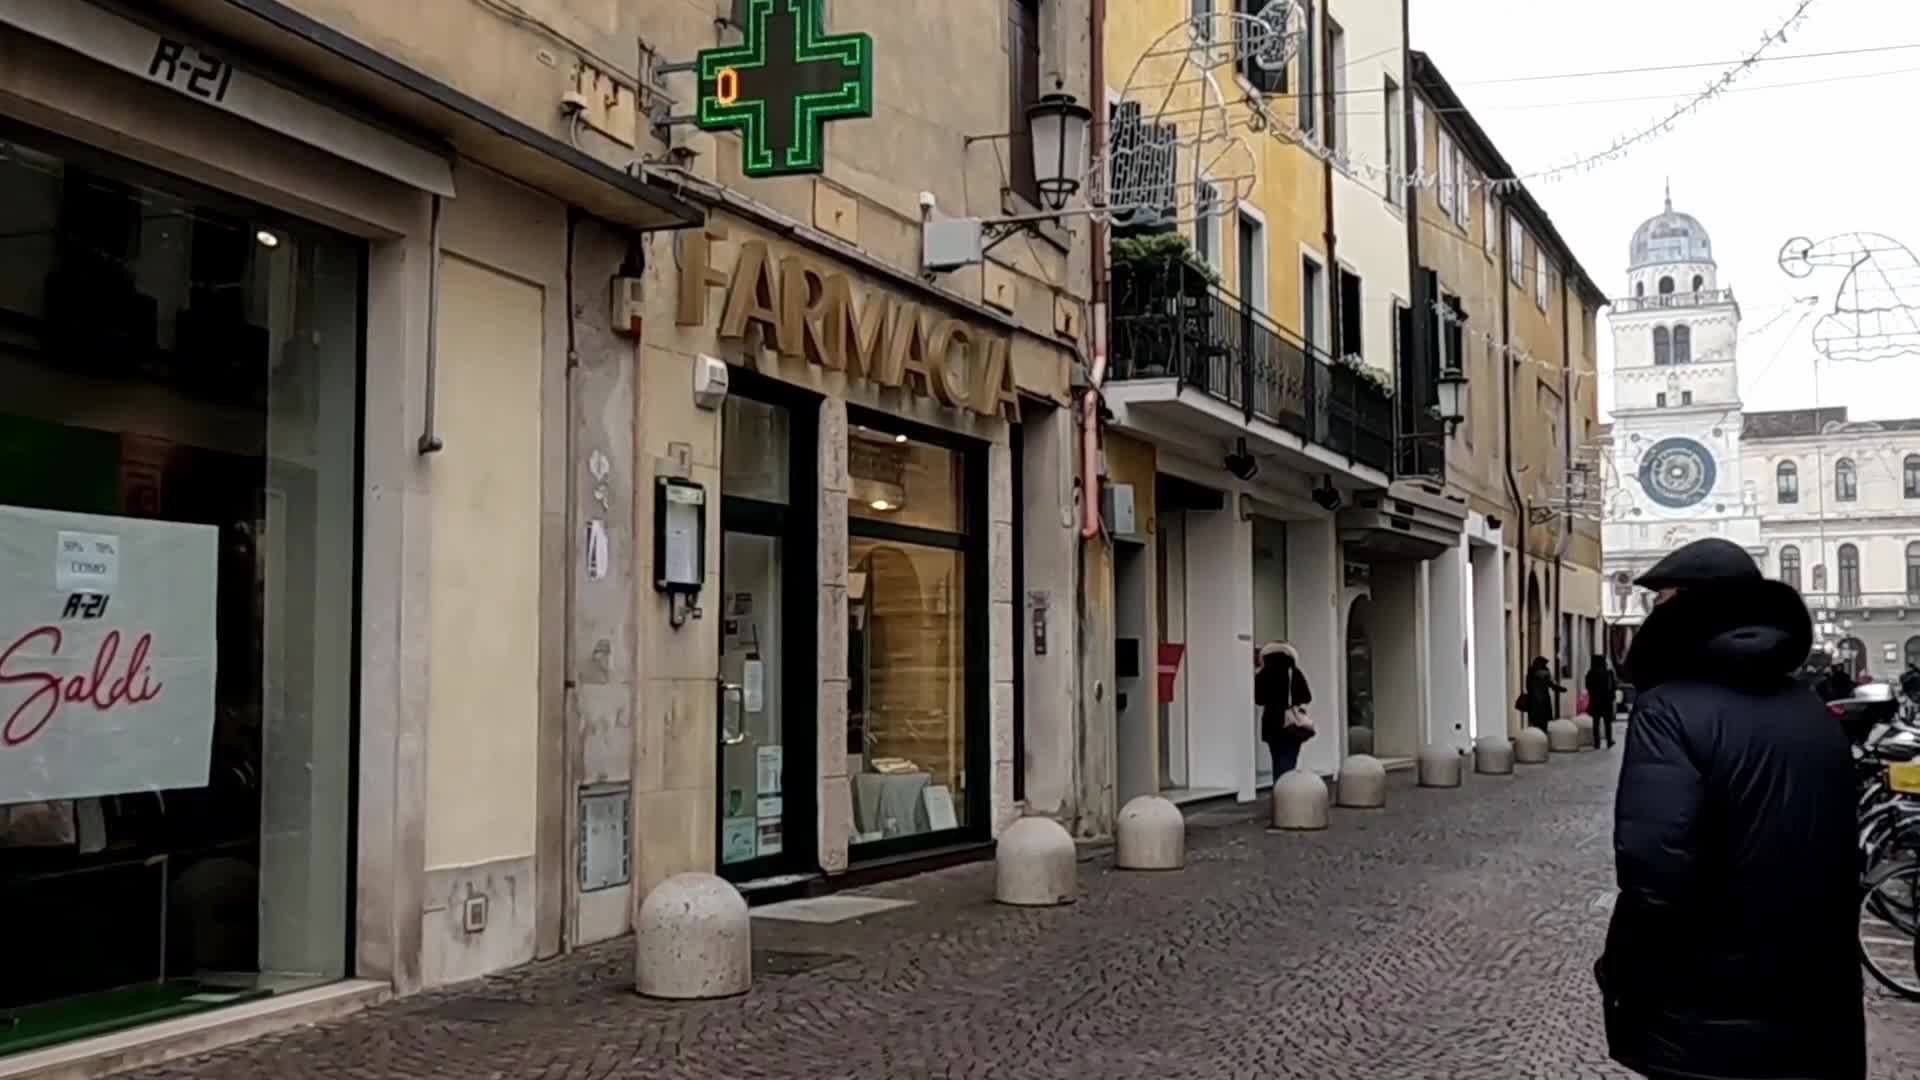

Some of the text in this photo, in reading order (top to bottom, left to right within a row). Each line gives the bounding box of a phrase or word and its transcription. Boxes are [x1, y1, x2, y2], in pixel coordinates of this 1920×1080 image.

[149, 37, 233, 101] R-21
[676, 223, 1022, 423] FARMACIA
[0, 626, 162, 745] Saldi
